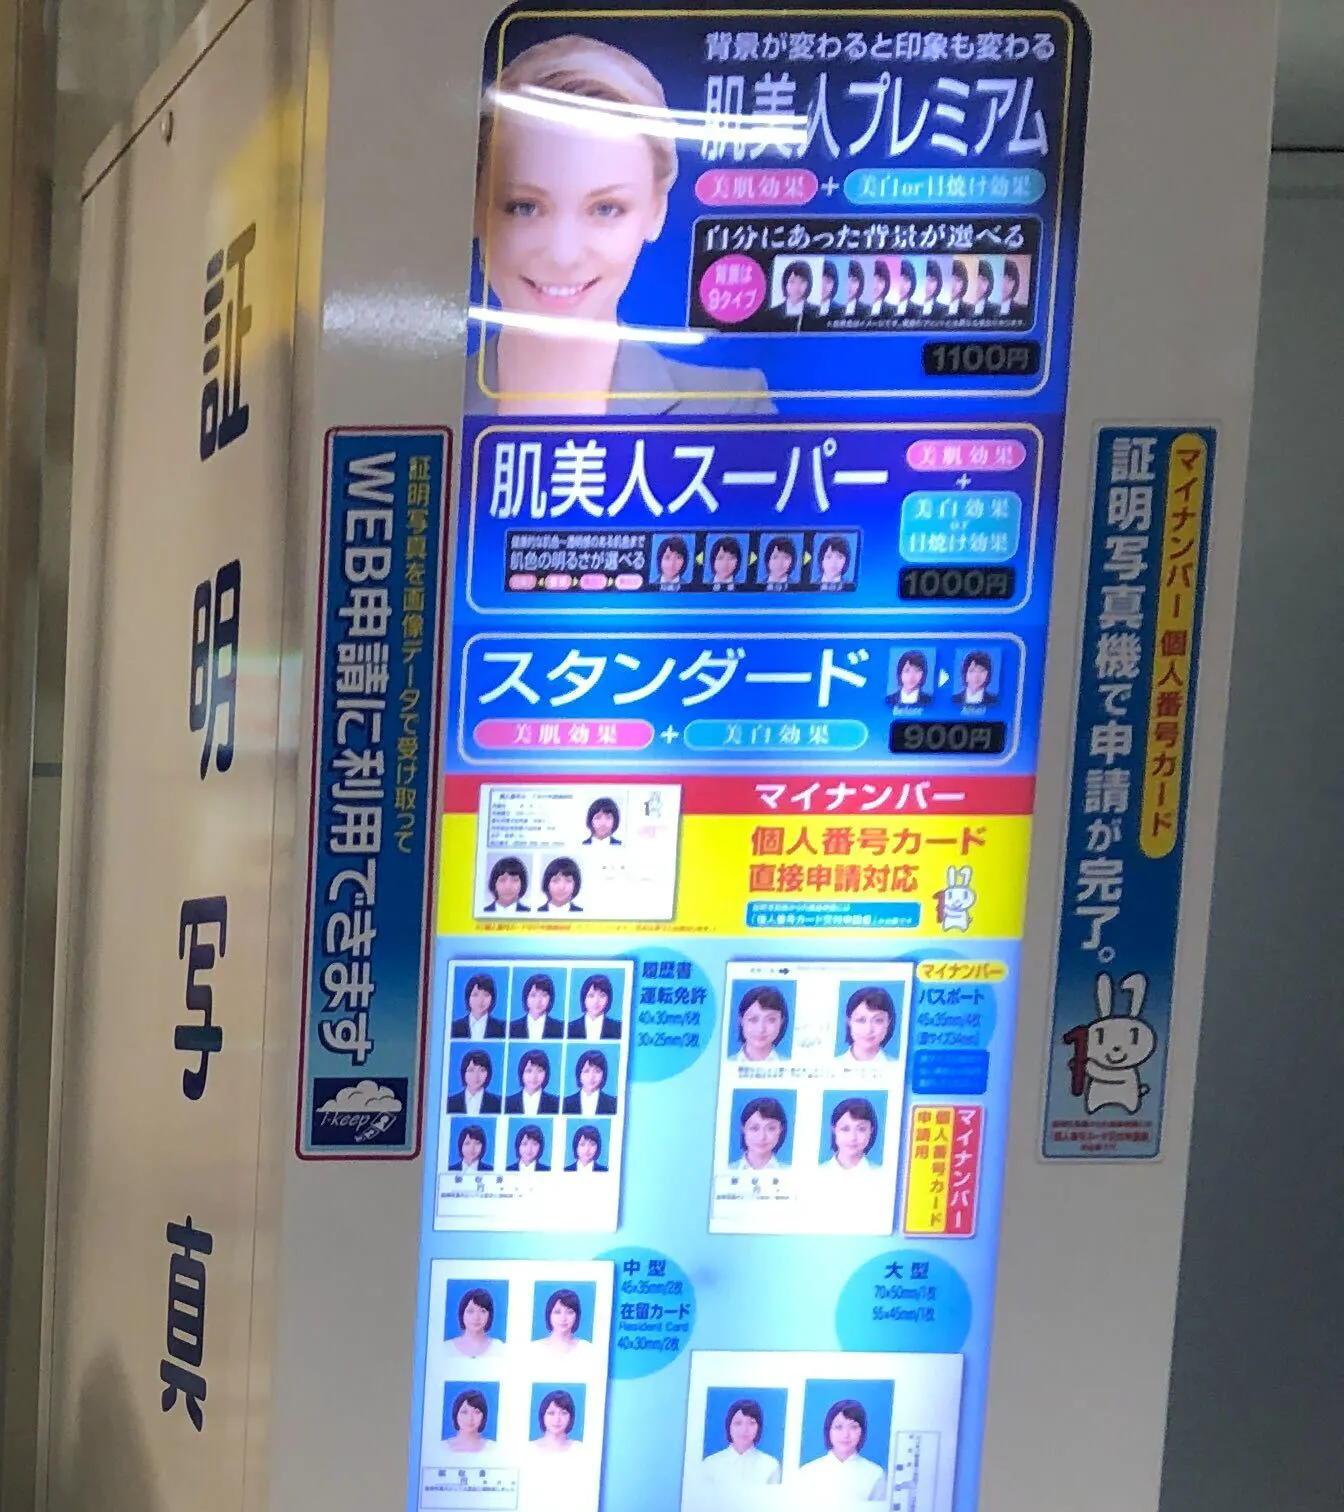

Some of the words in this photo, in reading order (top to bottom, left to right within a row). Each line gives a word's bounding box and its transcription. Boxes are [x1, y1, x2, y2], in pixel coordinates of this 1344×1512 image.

[706, 32, 1055, 61] 背景が変わると印象も変わる
[701, 74, 1049, 161] 肌美人プレミアム
[705, 224, 1024, 250] 自分にあった背景が選べる
[932, 346, 1029, 373] 1100円
[920, 445, 1013, 466] 美肌効果
[490, 438, 888, 519] 肌美人スーパー
[1163, 448, 1199, 621] マイナンバー
[905, 570, 1007, 596] 1000円
[396, 456, 432, 853] 証明写真を画像データで受け取って
[479, 647, 869, 708] スタンダード
[1076, 438, 1156, 962] 証明写真機で申請が完了。
[513, 724, 619, 744] 美肌効果
[723, 725, 830, 745] 美白効果
[904, 725, 991, 750] 900円
[1151, 629, 1187, 836] 個人番号カード
[320, 451, 395, 1065] WEB申請に利用できます
[755, 782, 966, 811] マイナンバー
[751, 826, 987, 857] 個人番号カード
[749, 864, 918, 894] 直接申請対応
[642, 962, 691, 979] 履歴書
[922, 964, 1003, 979] マイナンバー
[640, 987, 707, 1005] 運転免許
[919, 988, 984, 1005] パスポート
[951, 1111, 973, 1230] マイナンバー
[620, 1303, 690, 1320] 在留カード
